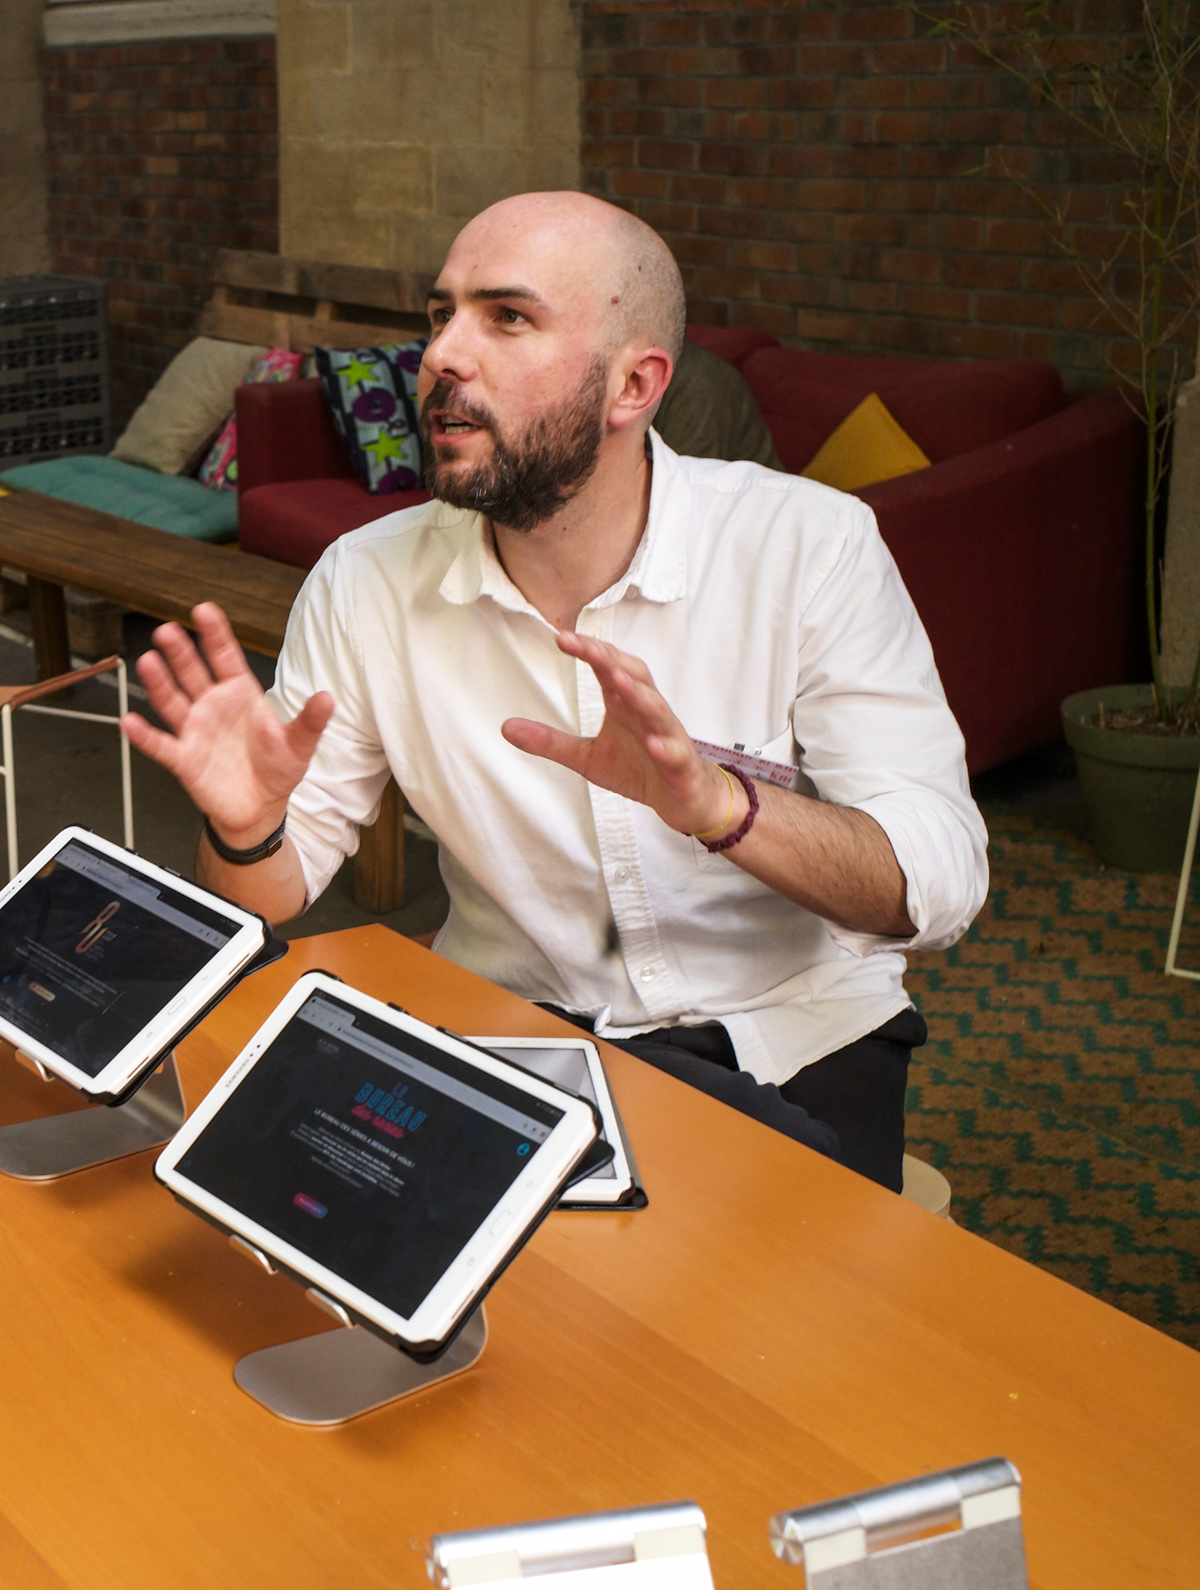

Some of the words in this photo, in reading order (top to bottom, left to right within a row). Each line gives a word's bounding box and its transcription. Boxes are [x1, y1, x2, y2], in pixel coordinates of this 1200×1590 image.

[320, 1111, 341, 1127] BUREAU
[340, 1122, 352, 1132] DES
[354, 1082, 428, 1132] BUREAU
